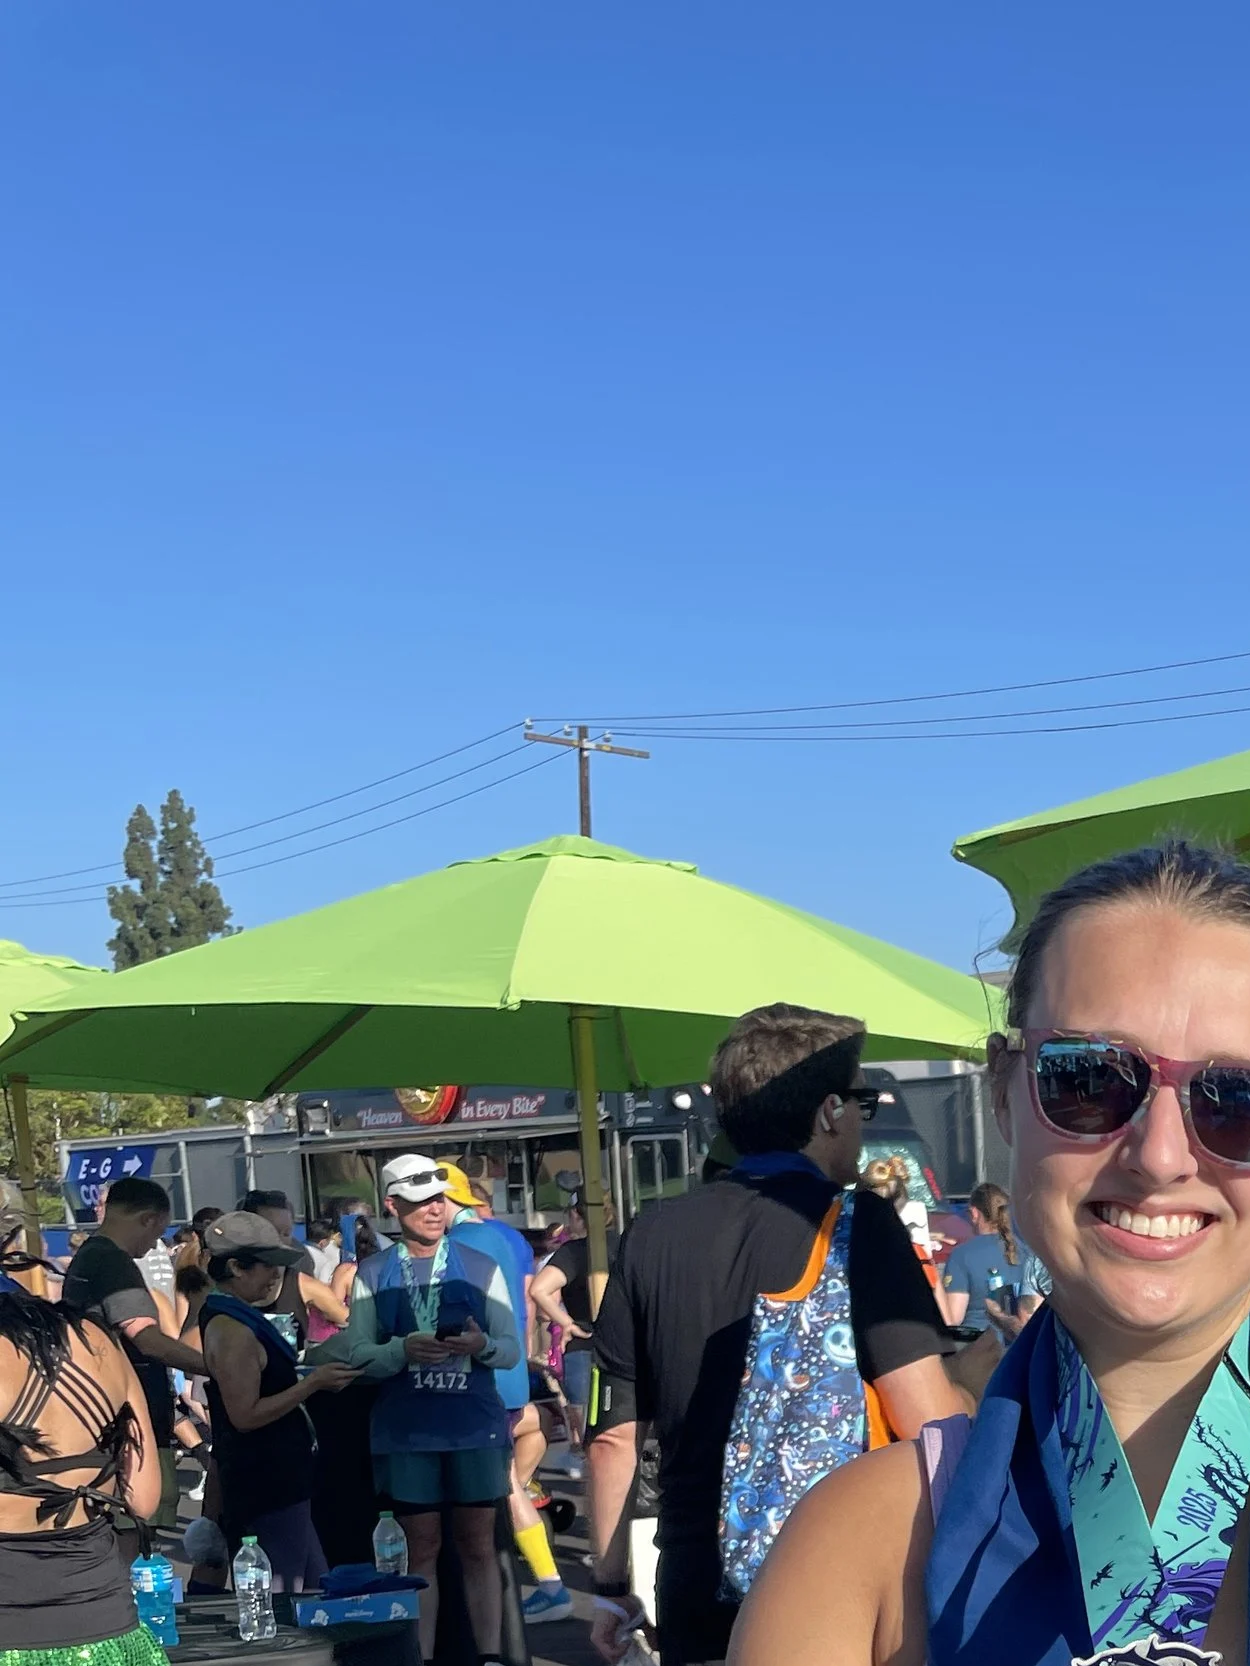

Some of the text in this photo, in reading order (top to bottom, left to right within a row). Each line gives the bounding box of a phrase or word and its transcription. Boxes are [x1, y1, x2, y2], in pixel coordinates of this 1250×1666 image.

[461, 1101, 475, 1119] in
[476, 1099, 511, 1121] Every
[413, 1371, 469, 1390] 14172
[1176, 1487, 1218, 1533] 2025
